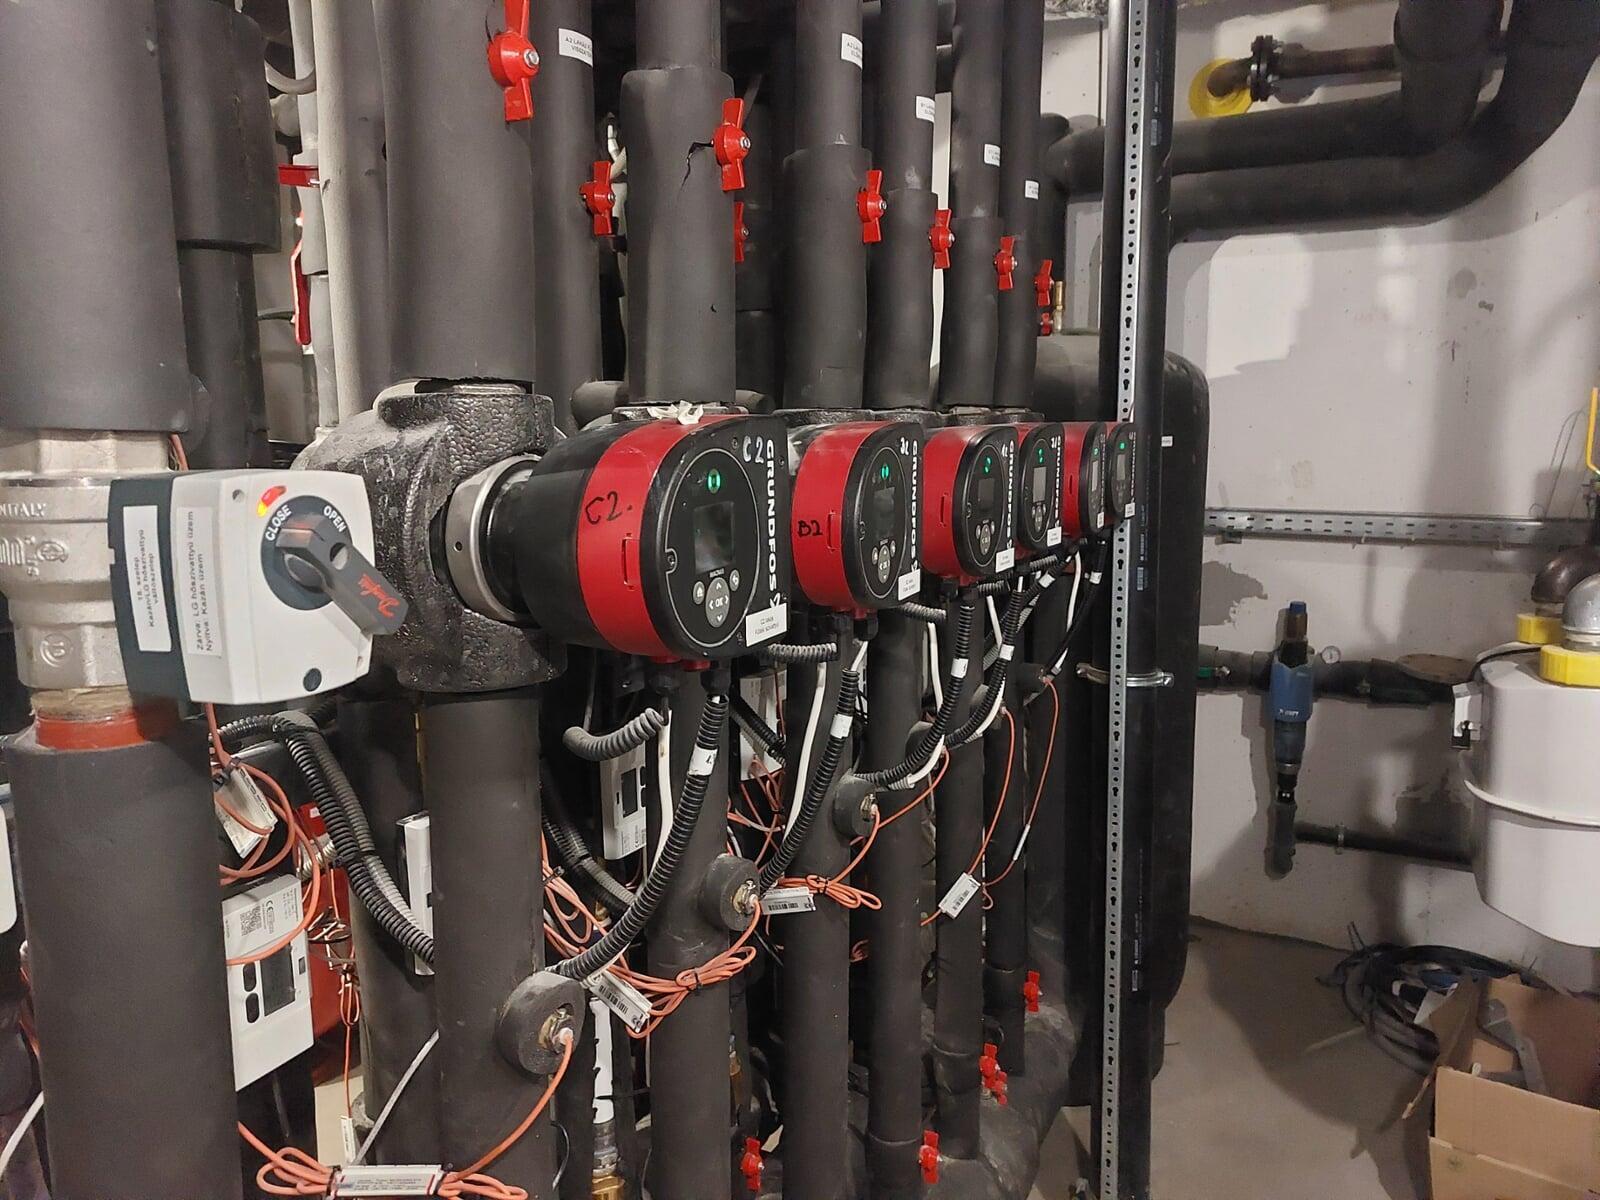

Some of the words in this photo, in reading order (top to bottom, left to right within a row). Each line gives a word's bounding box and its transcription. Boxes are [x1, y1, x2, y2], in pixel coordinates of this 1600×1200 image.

[743, 435, 764, 464] C2
[1007, 440, 1015, 538] GRUNDFOS
[265, 504, 292, 541] CLOSE
[323, 505, 347, 533] OPEN
[767, 439, 777, 591] GRUNDFOS
[797, 519, 823, 537] B2
[133, 556, 141, 587] szelep
[191, 603, 199, 617] LG
